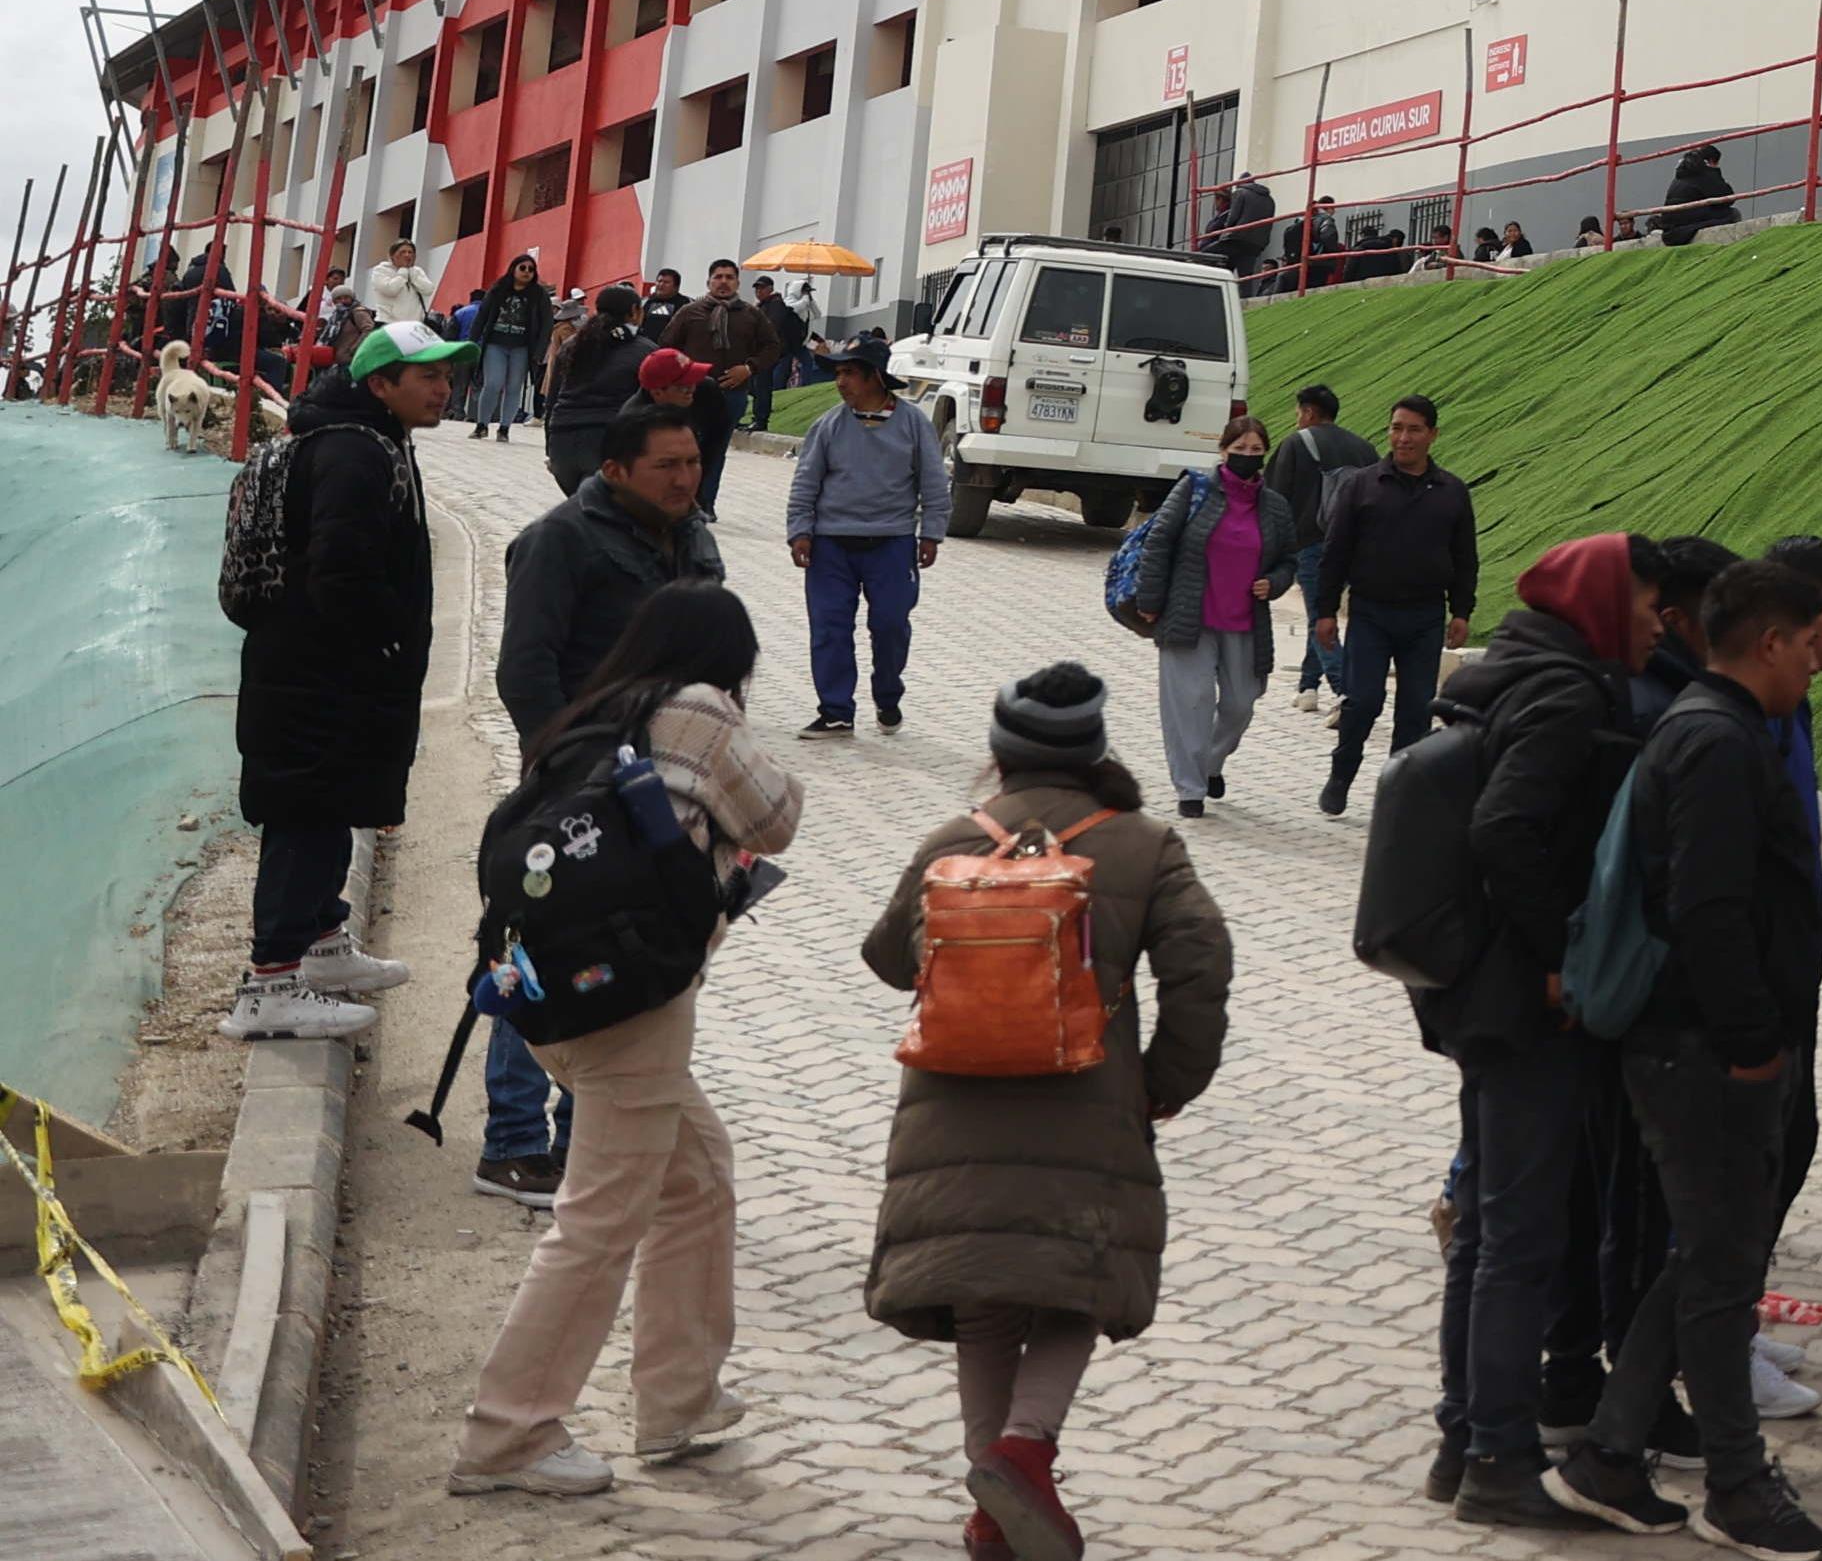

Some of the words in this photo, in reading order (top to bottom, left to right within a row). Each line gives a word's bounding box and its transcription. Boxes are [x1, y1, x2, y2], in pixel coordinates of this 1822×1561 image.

[1318, 118, 1367, 152] OLETERÍA
[1370, 110, 1406, 138] CURVA
[1408, 104, 1430, 128] SUR
